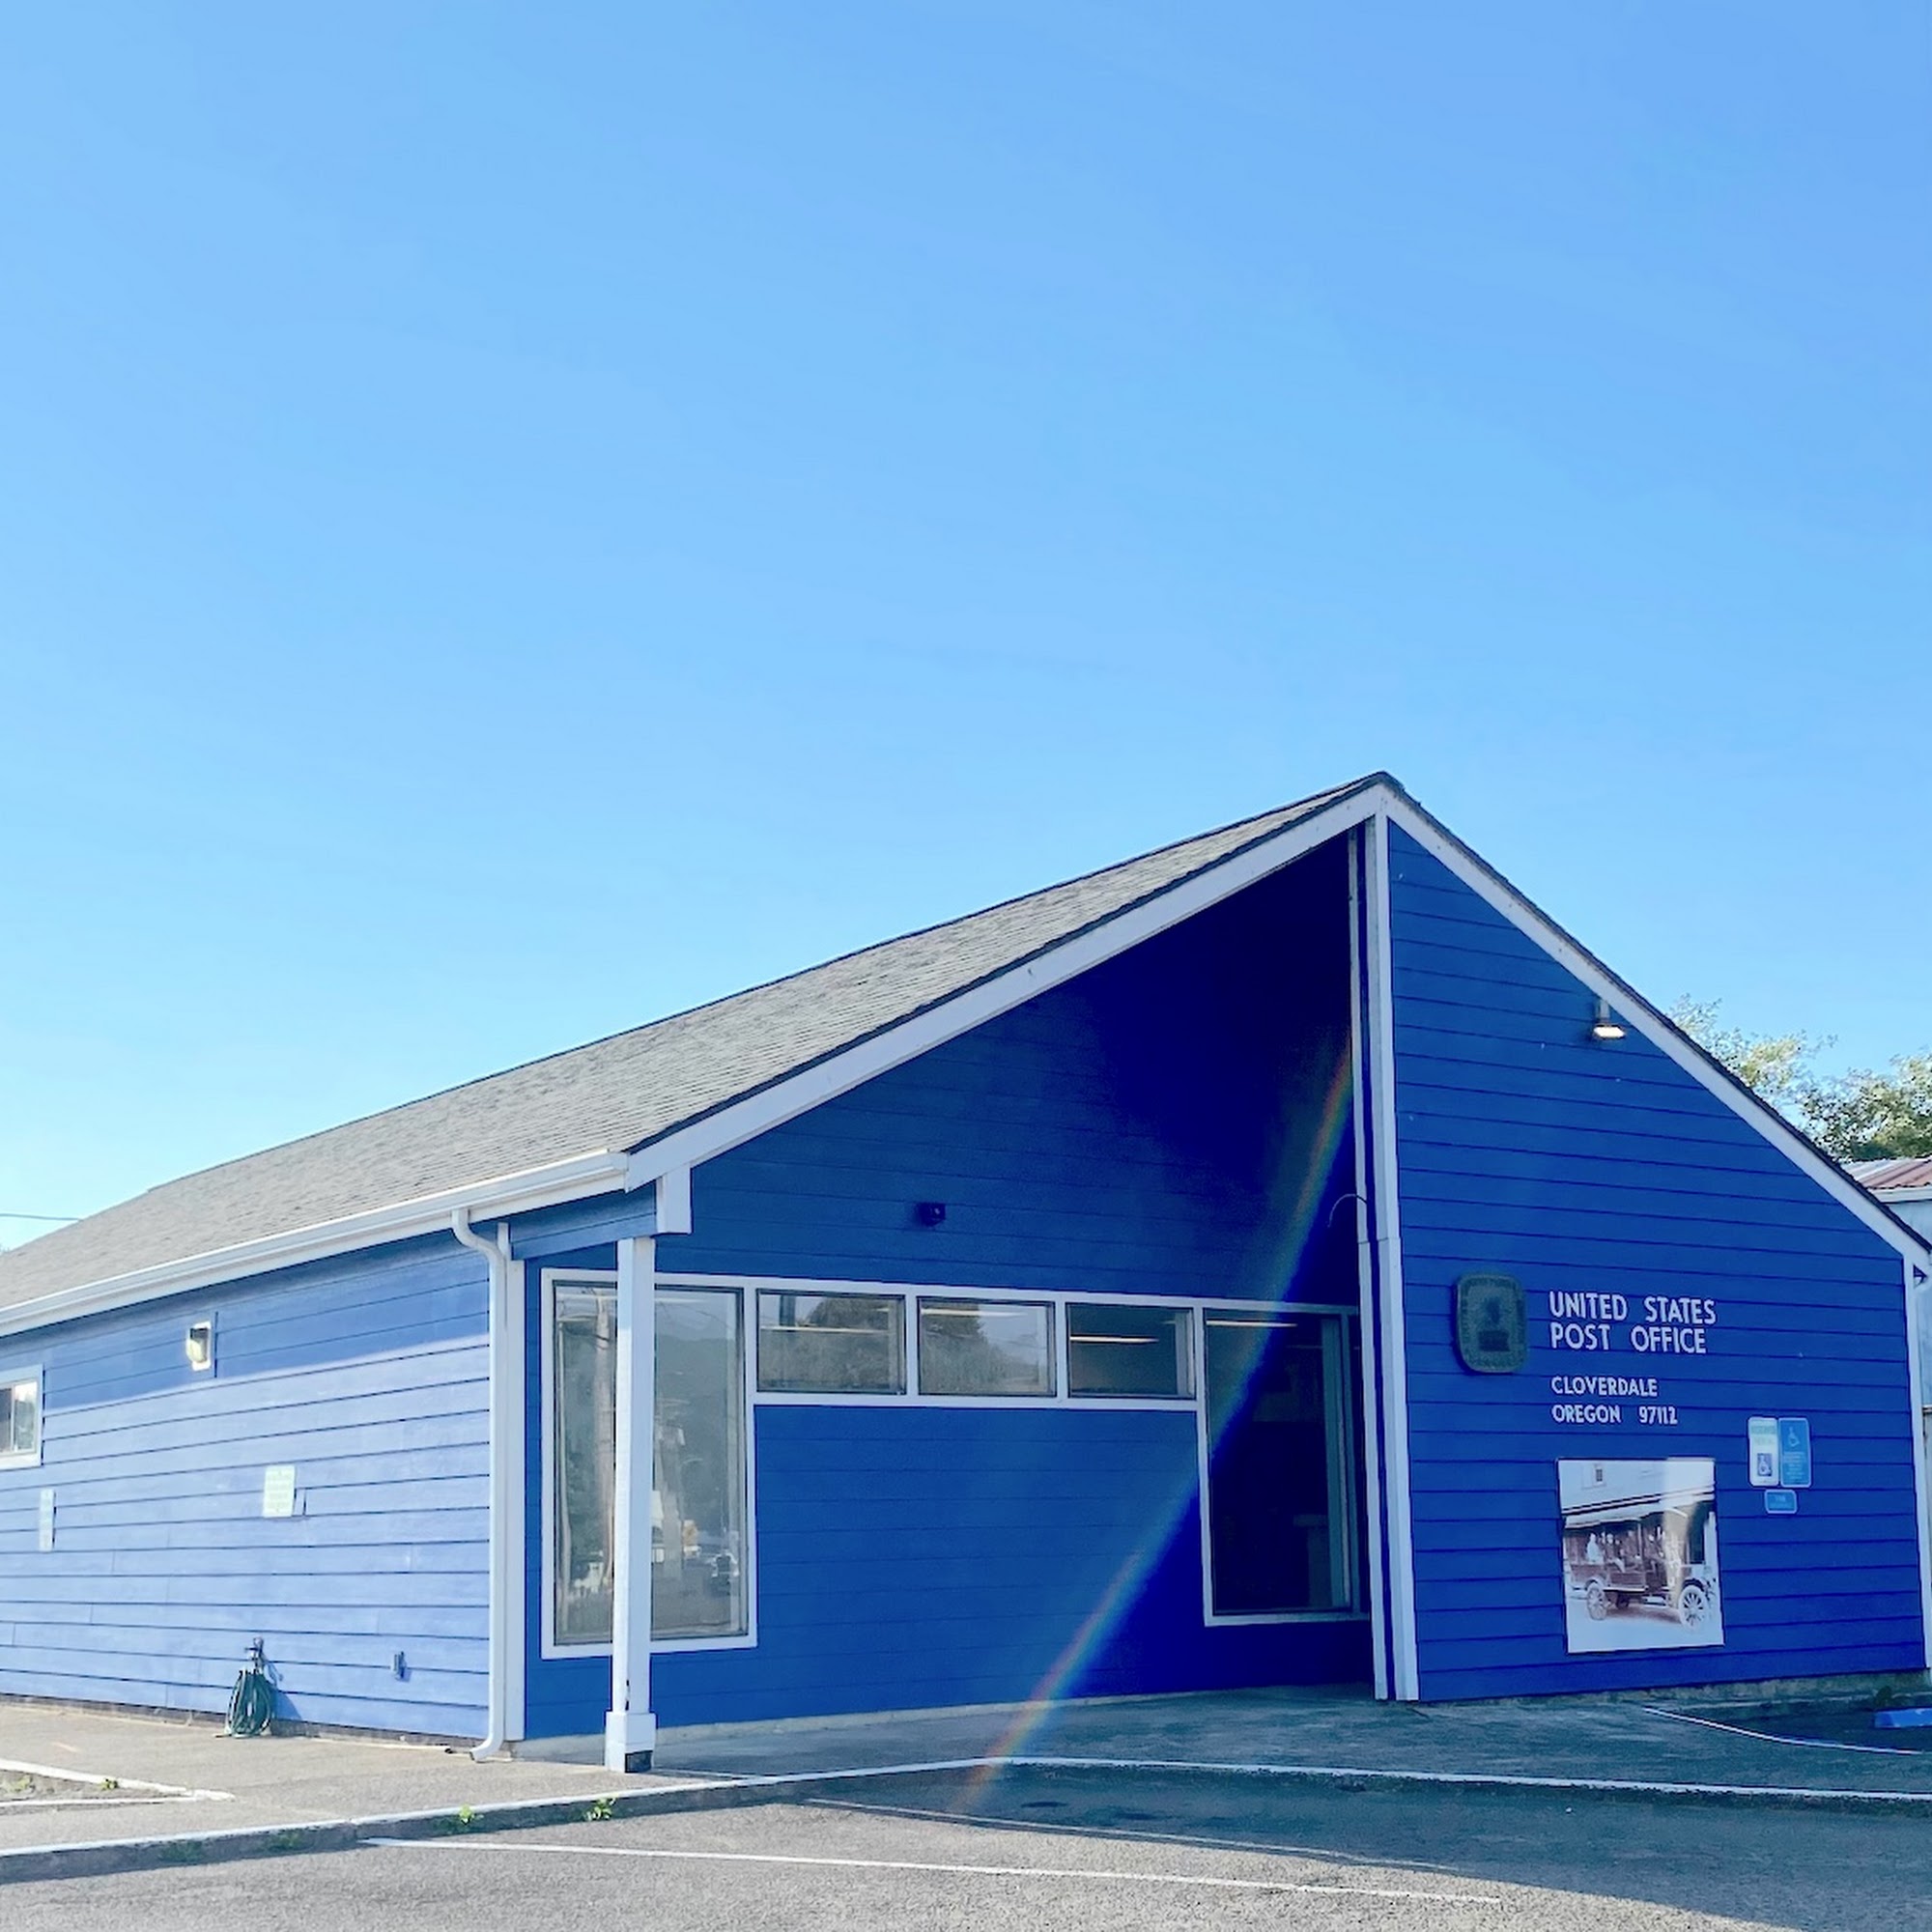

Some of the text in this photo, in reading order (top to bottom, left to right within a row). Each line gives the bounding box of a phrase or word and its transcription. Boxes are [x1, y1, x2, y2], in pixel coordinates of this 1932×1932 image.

[1549, 1291, 1718, 1324] UNITED STATES
[1549, 1323, 1706, 1353] POST OFFICE
[1551, 1377, 1658, 1397] CLOVERDALE
[1551, 1405, 1679, 1425] OREGON 97112
